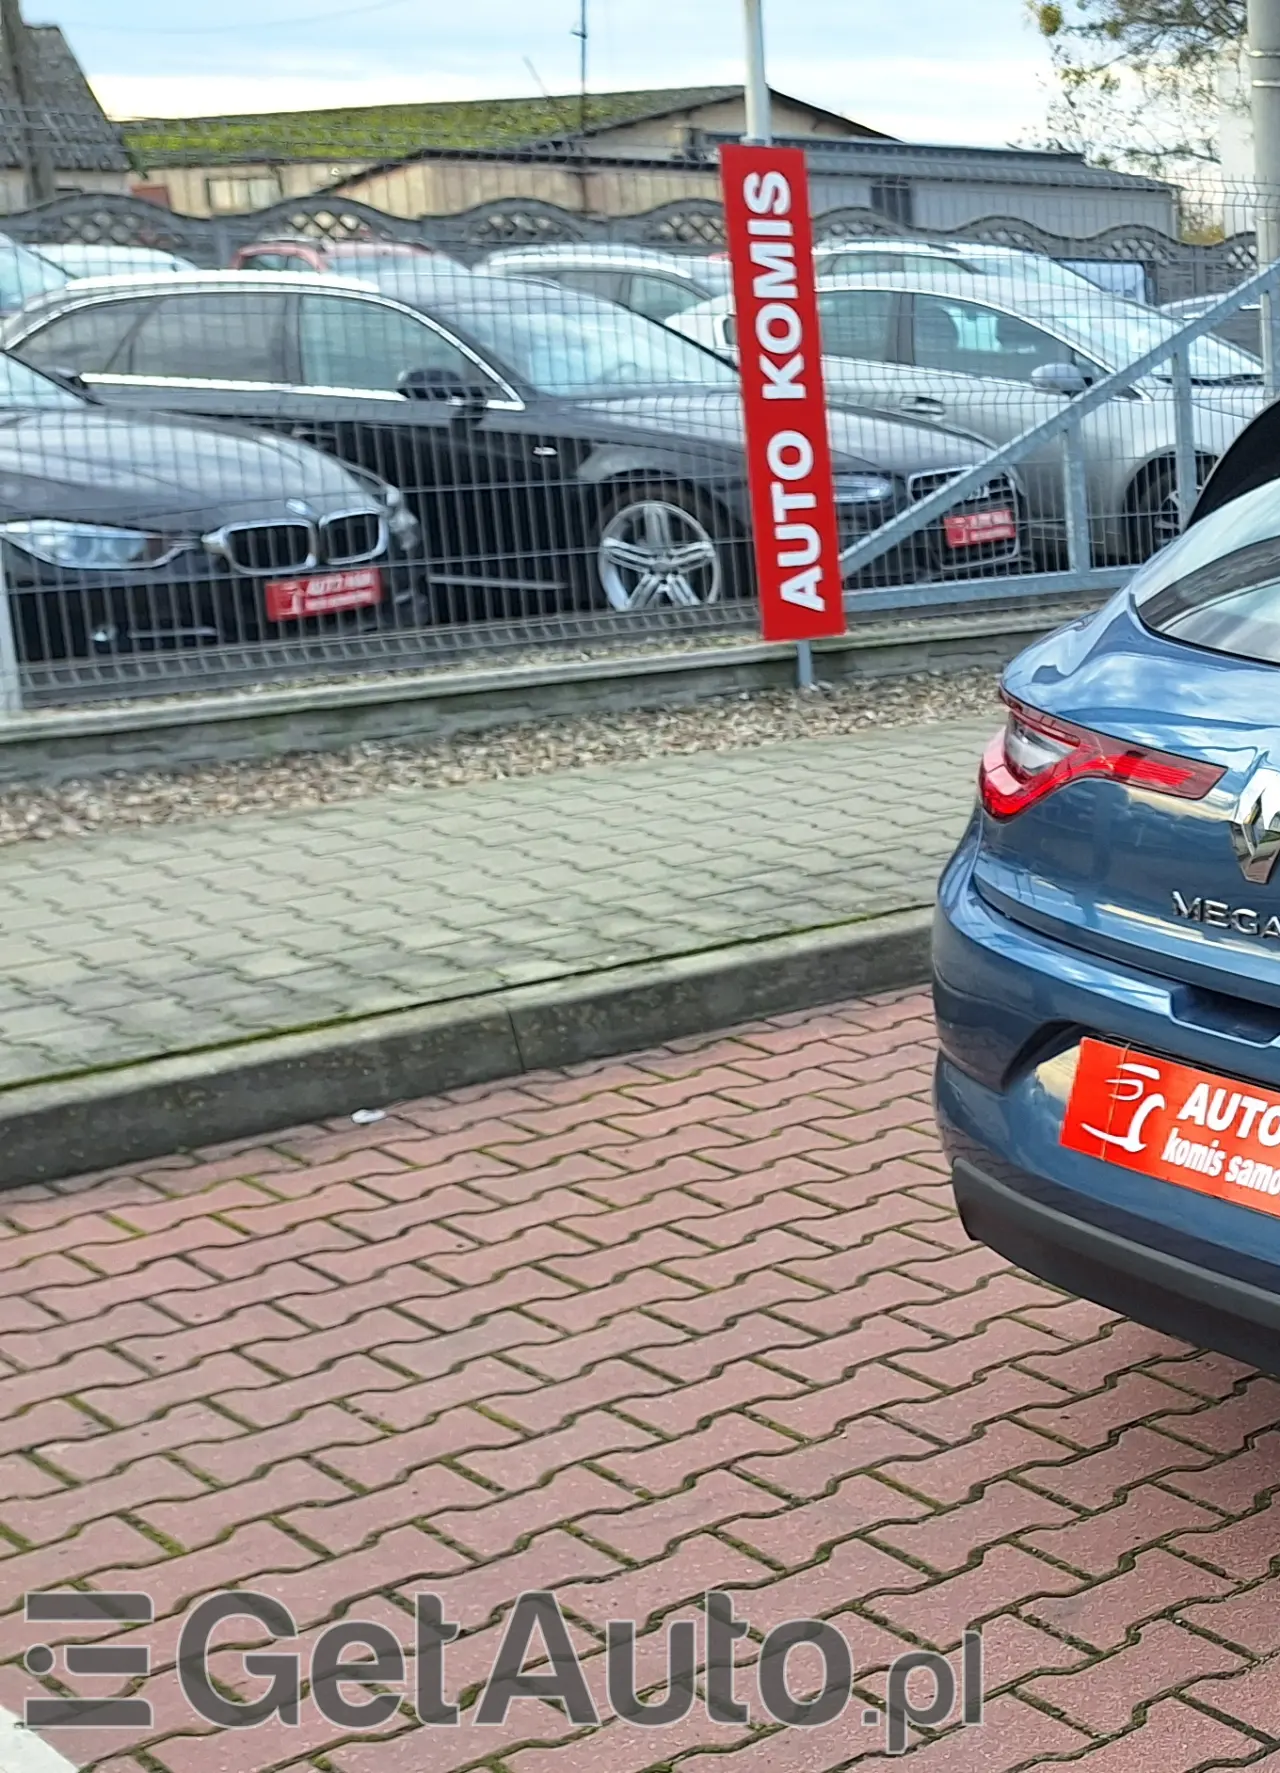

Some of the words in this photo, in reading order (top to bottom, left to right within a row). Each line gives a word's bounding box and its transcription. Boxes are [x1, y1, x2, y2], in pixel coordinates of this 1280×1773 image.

[742, 170, 807, 401] KOMIS
[766, 429, 826, 612] AUTO
[1161, 1128, 1227, 1177] komis
